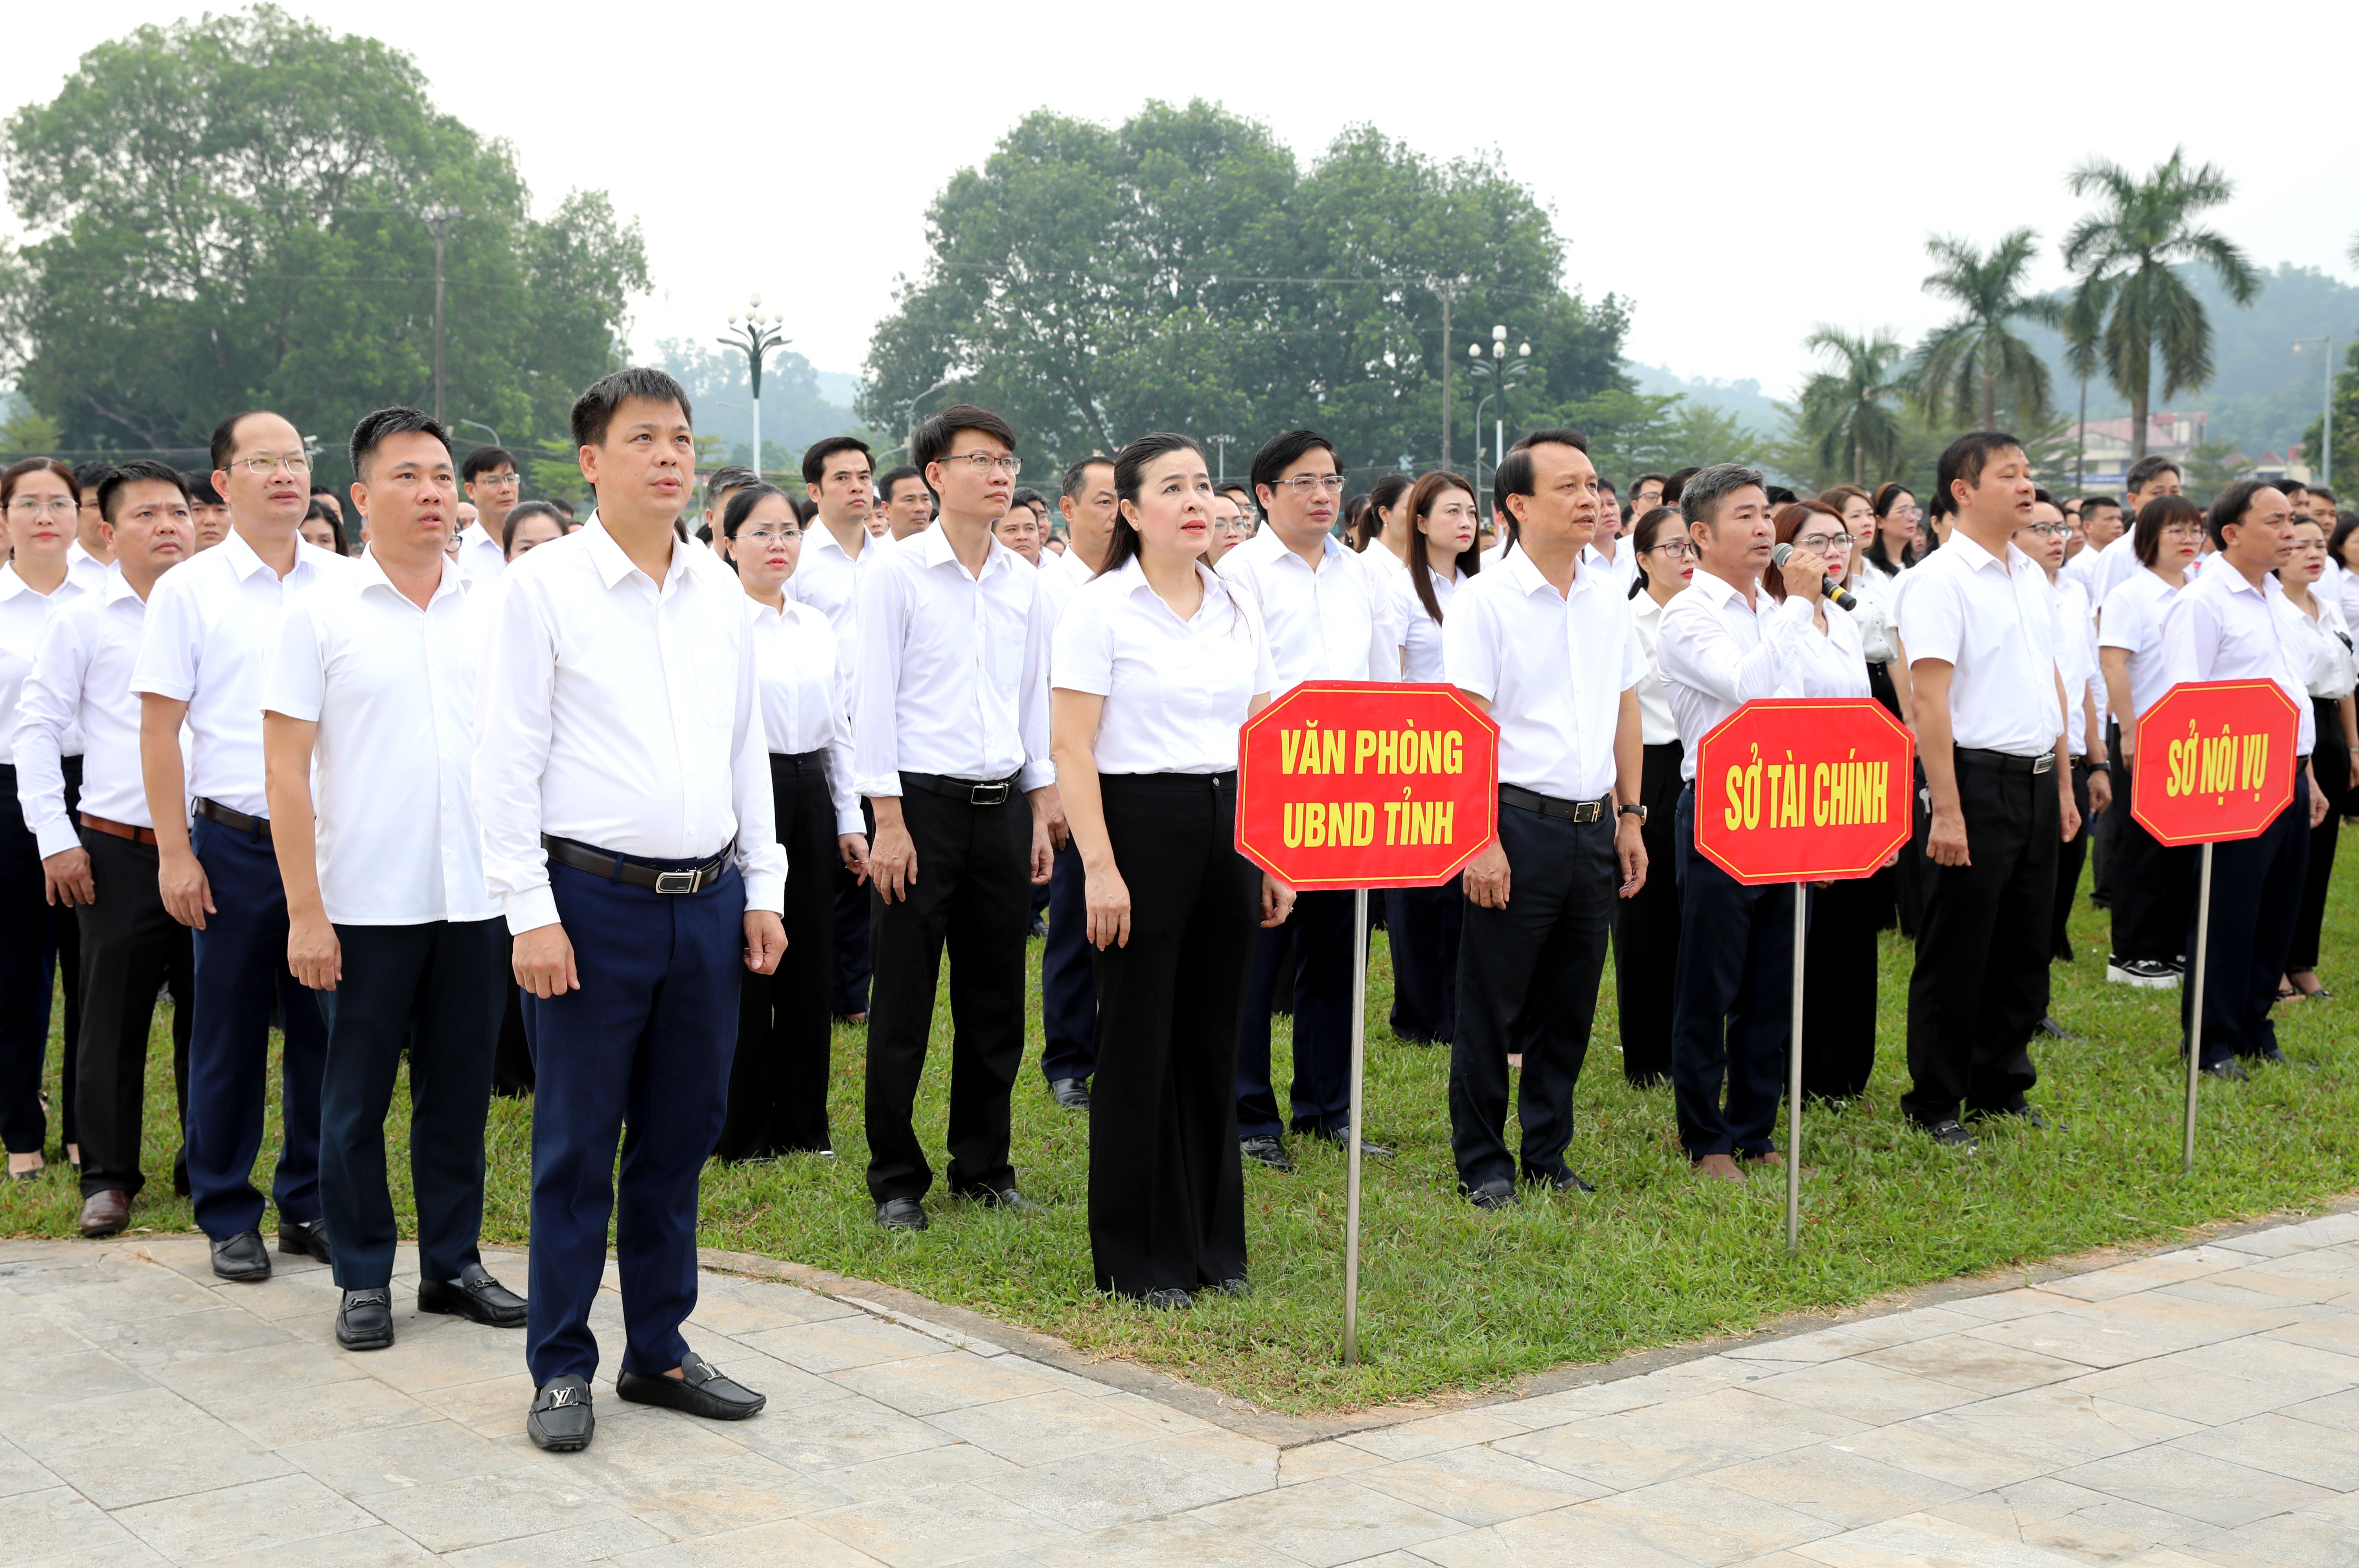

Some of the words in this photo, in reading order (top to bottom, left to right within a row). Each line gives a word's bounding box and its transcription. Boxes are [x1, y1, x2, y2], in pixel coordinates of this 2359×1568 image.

[1280, 719, 1346, 774] VĂN
[1354, 719, 1463, 775] PHÒNG
[2166, 718, 2199, 797] SỞ
[2199, 723, 2239, 806] NỘI
[2242, 733, 2269, 802] VỤ
[1283, 802, 1375, 848] UBND
[1384, 786, 1454, 845] TỈNH
[1724, 742, 1763, 831] SỞ
[1767, 750, 1807, 828] TÀI
[1813, 748, 1888, 826] CHÍNH
